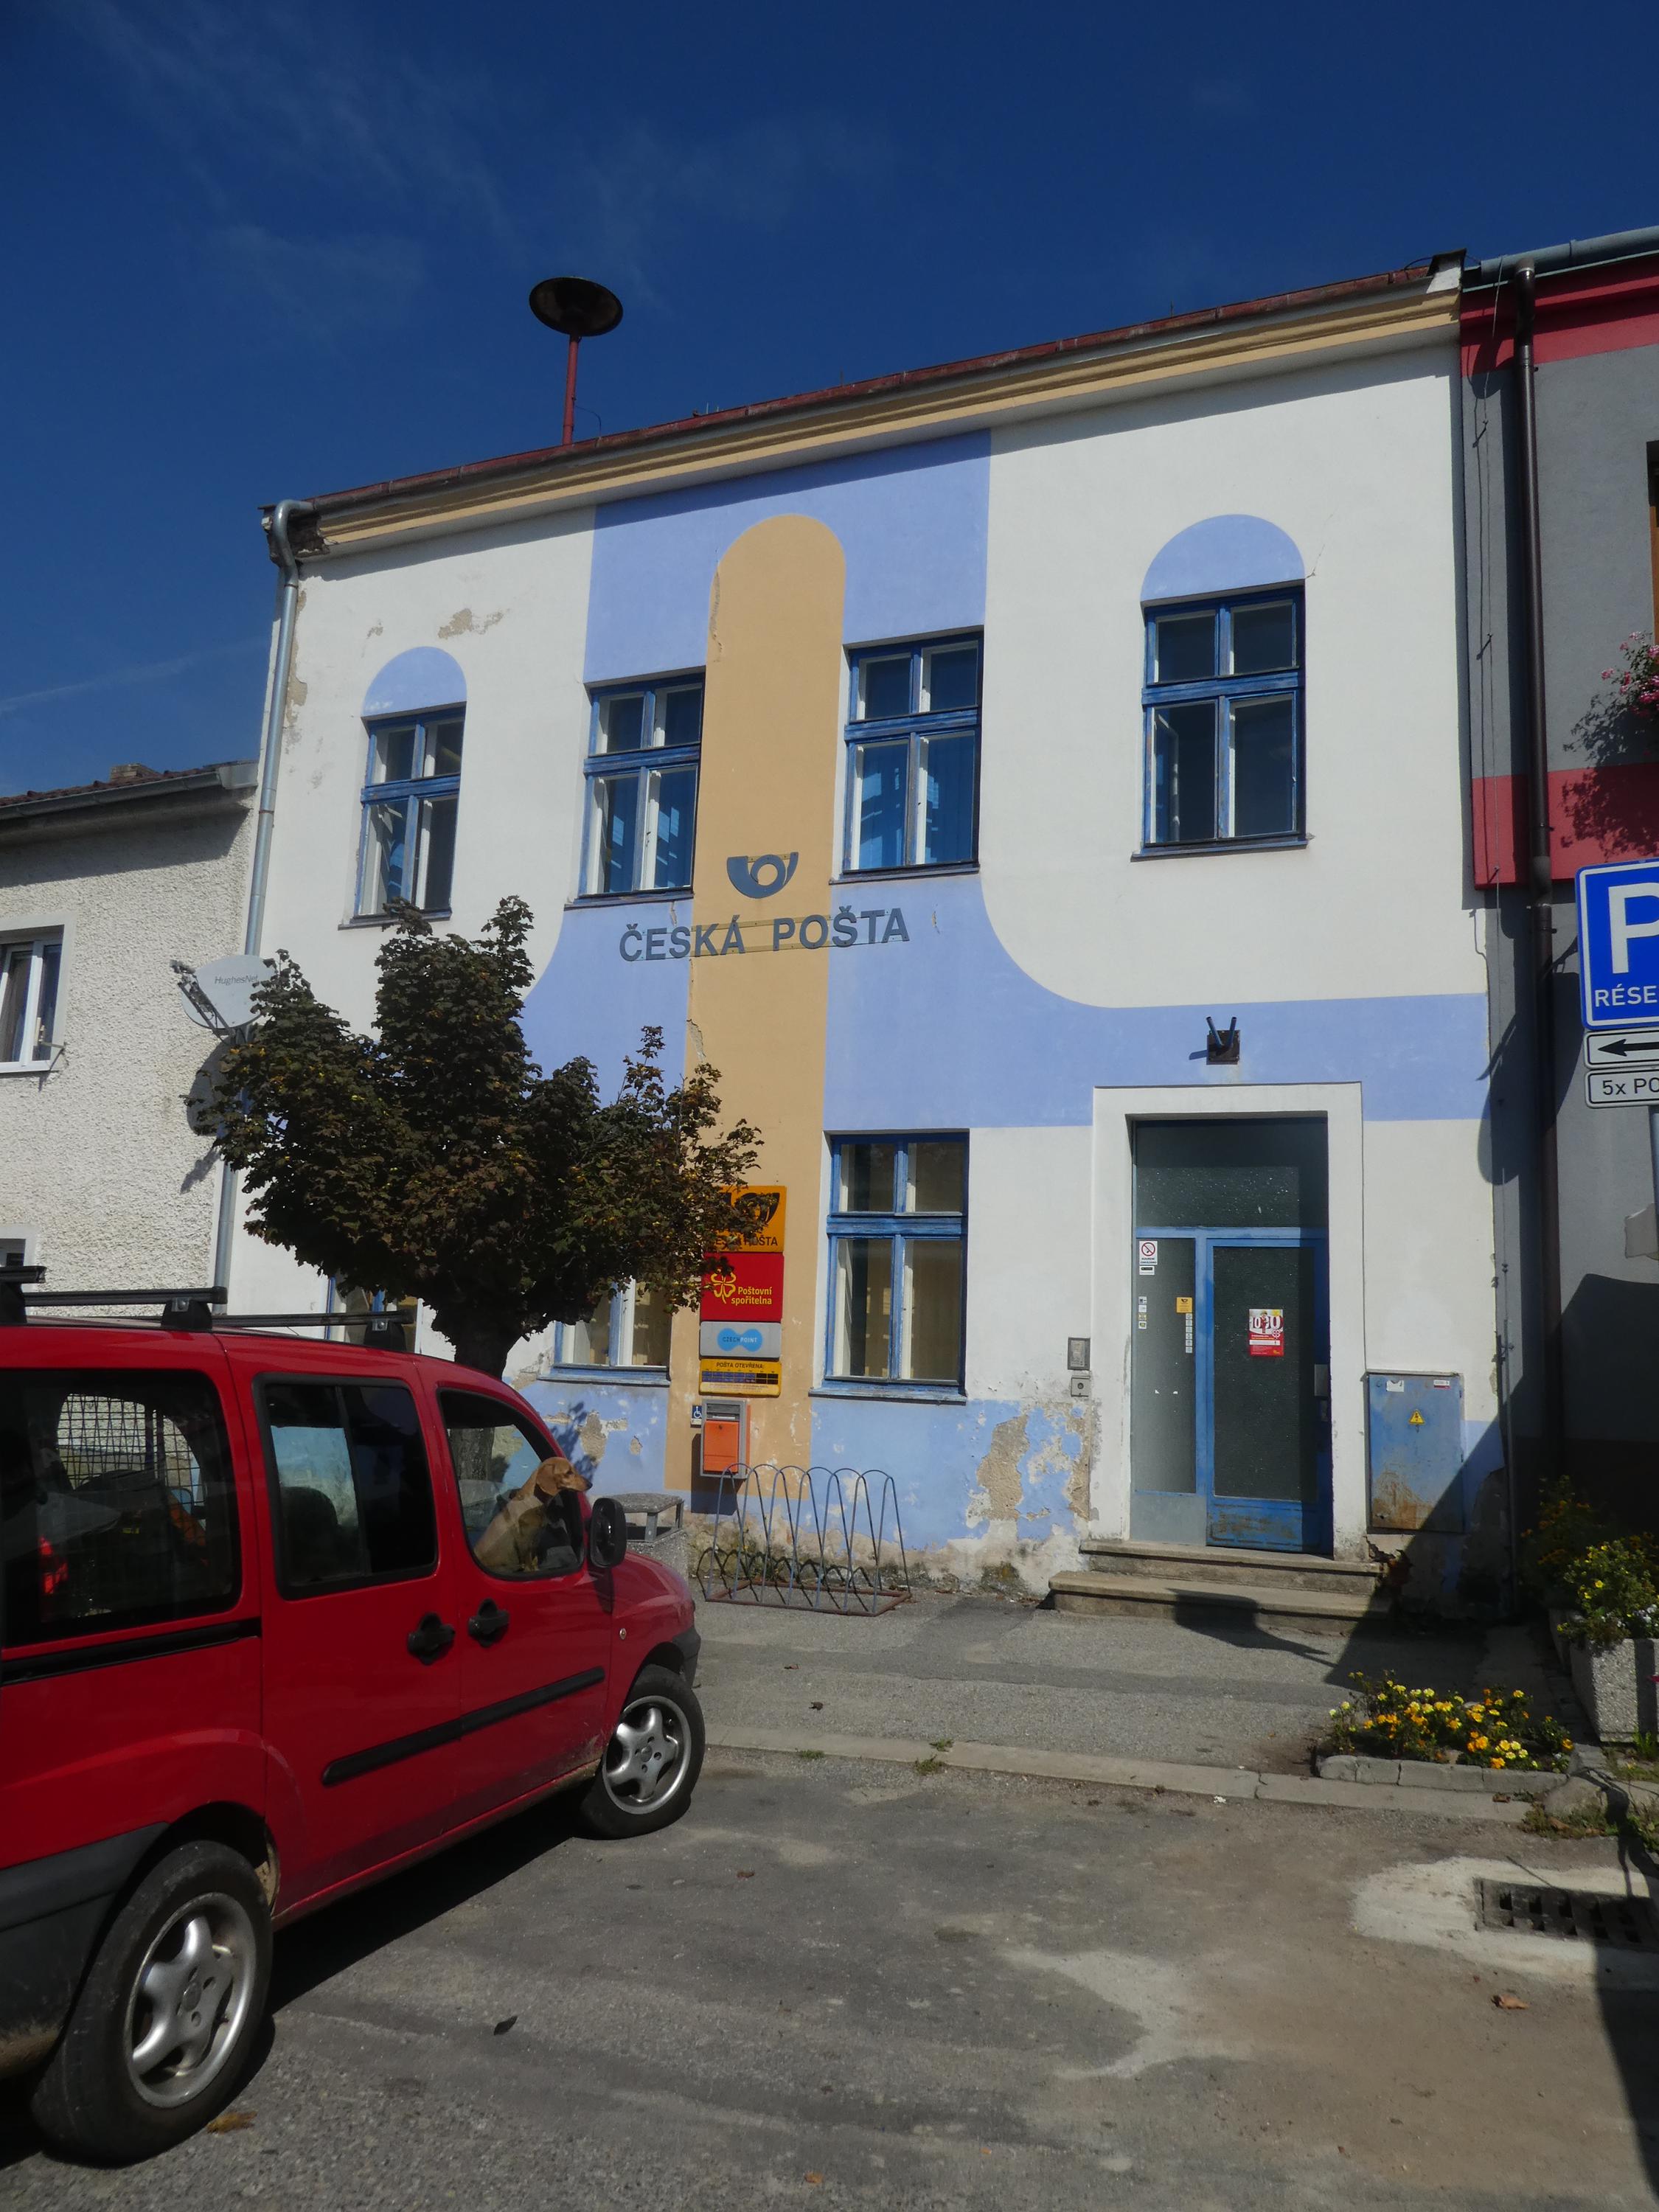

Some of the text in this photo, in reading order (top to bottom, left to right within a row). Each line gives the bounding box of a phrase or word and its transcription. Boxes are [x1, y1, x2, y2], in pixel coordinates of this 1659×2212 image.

[619, 905, 910, 961] ČESKÁ POŠTA
[1608, 882, 1659, 974] P
[215, 975, 258, 986] HughesNet
[1602, 1079, 1626, 1096] 5x
[738, 1287, 772, 1295] Poštovní
[731, 1295, 772, 1306] spořitelna
